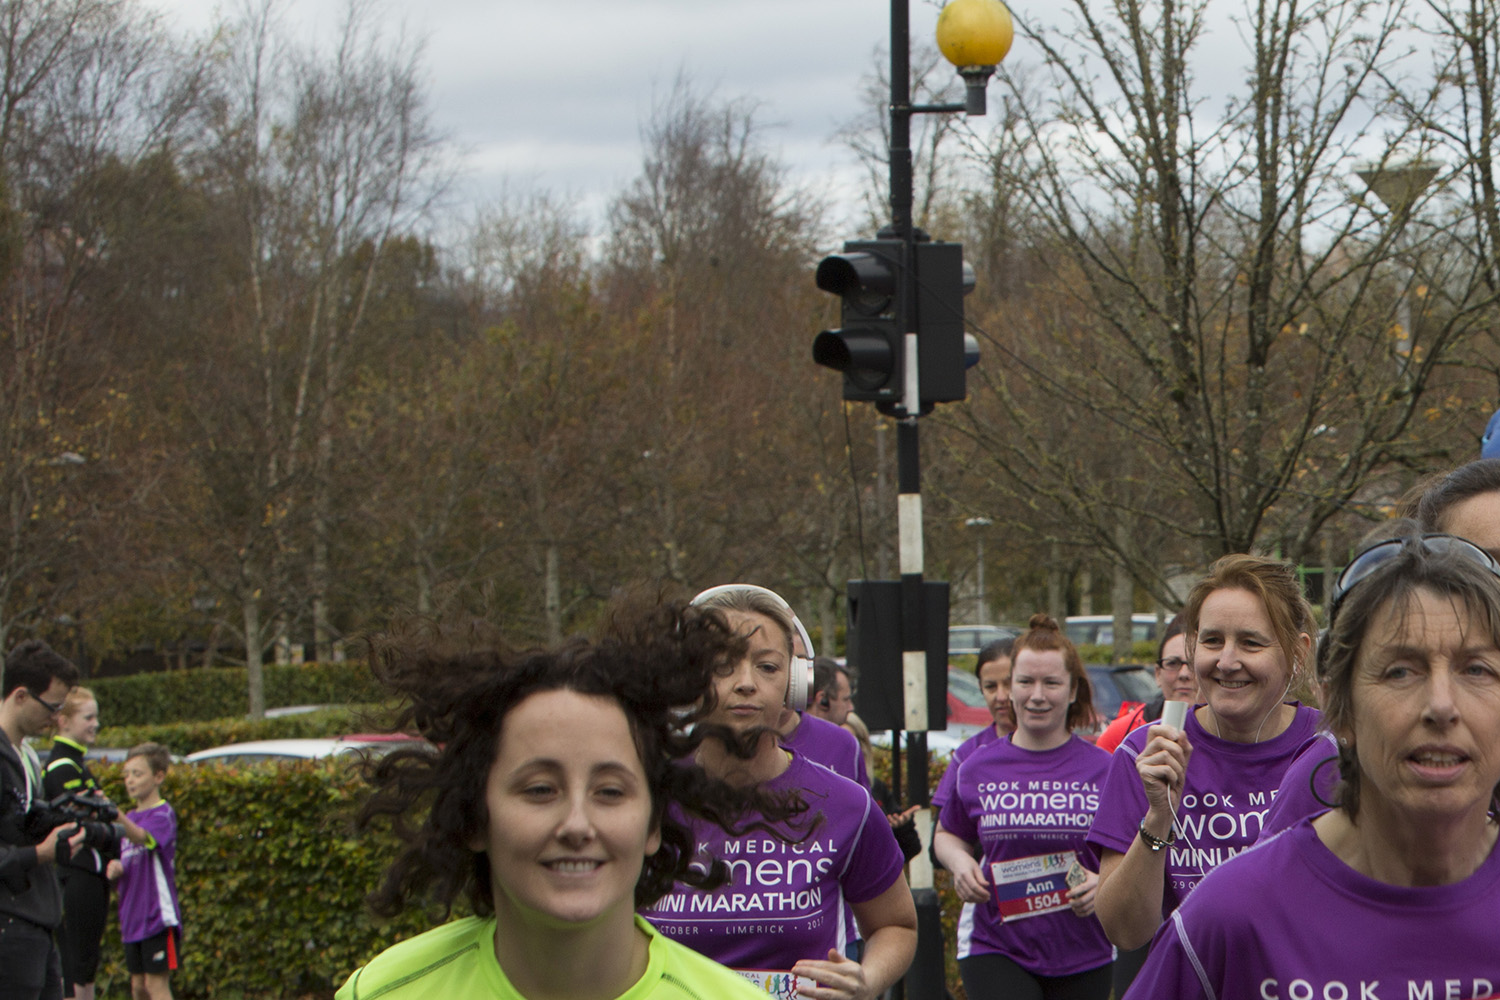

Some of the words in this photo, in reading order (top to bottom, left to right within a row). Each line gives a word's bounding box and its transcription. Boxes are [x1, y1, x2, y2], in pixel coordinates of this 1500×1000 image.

[977, 781, 1020, 793] COOK
[1028, 781, 1099, 792] MEDICAL
[979, 792, 1100, 811] womens
[1182, 793, 1234, 808] OOK
[980, 813, 1007, 828] MINI
[1170, 848, 1222, 867] MINI
[1026, 881, 1054, 895] Ann
[690, 887, 822, 912] MARATHON
[1026, 892, 1061, 911] 1504
[726, 925, 784, 934] LIMERICK
[807, 916, 825, 930] 2017
